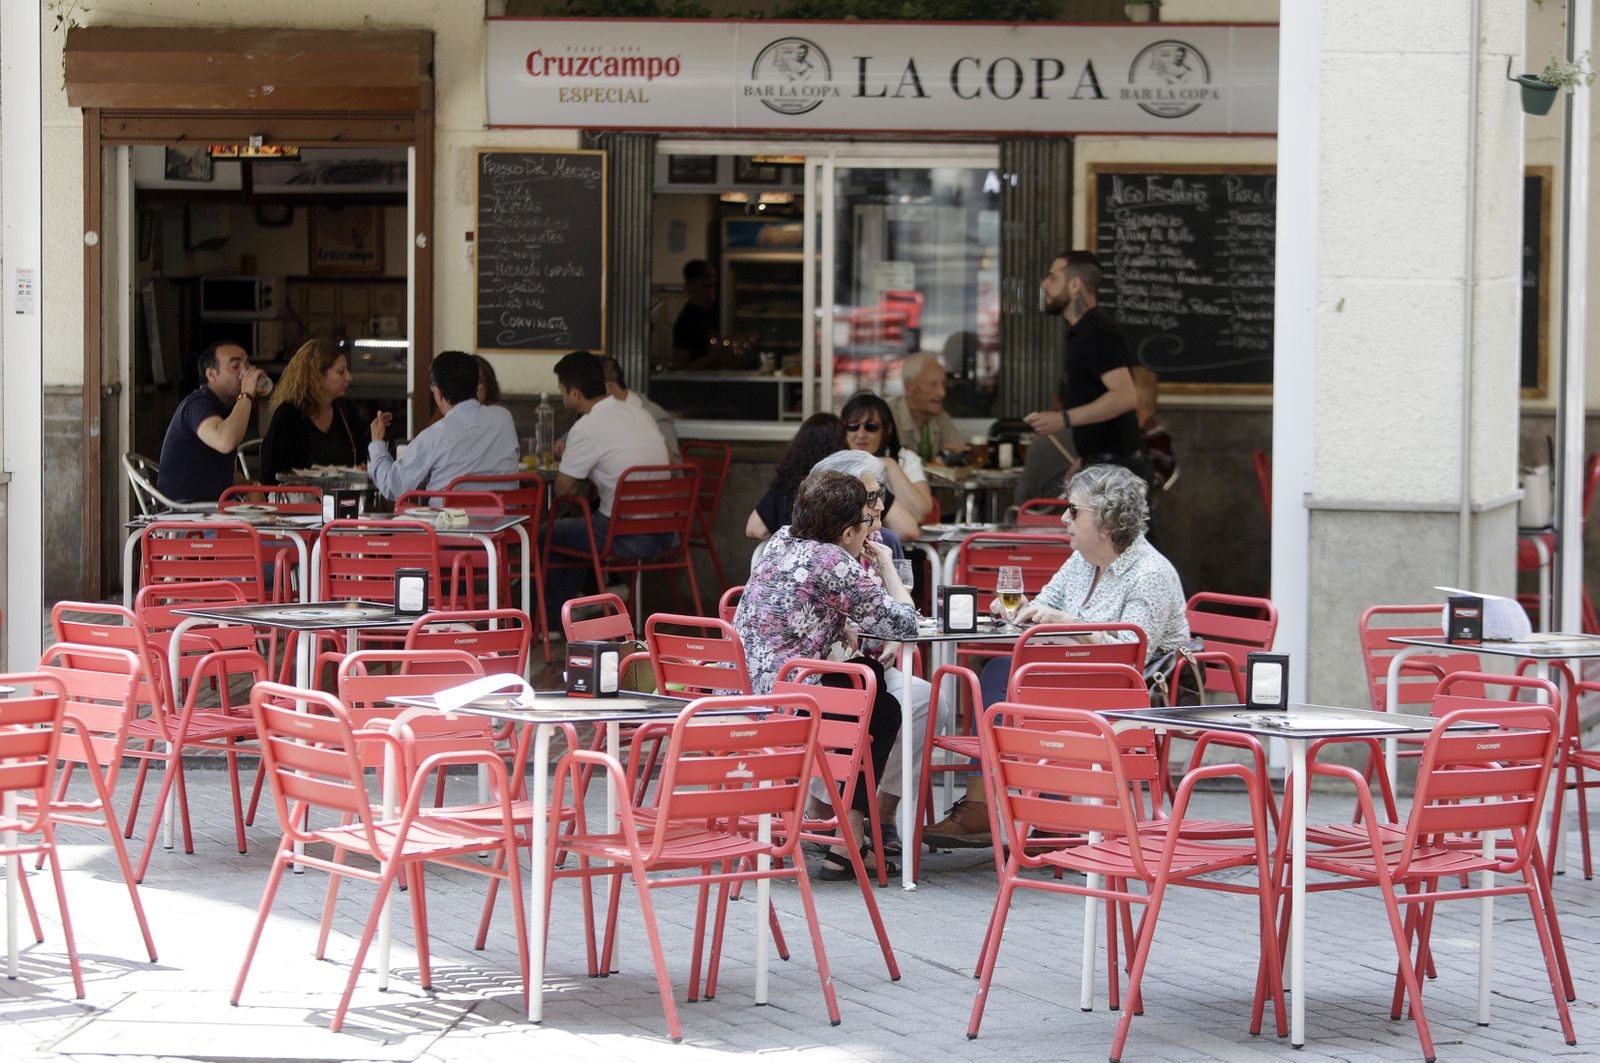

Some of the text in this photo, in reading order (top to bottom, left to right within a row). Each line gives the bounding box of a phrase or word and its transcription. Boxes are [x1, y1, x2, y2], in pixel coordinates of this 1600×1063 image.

[526, 48, 681, 81] Cruzcampo
[851, 55, 1109, 100] LA COPA
[558, 87, 649, 103] ESPECIAL
[743, 85, 841, 97] BAR LA COPA
[1119, 88, 1219, 101] BAR LA COPA
